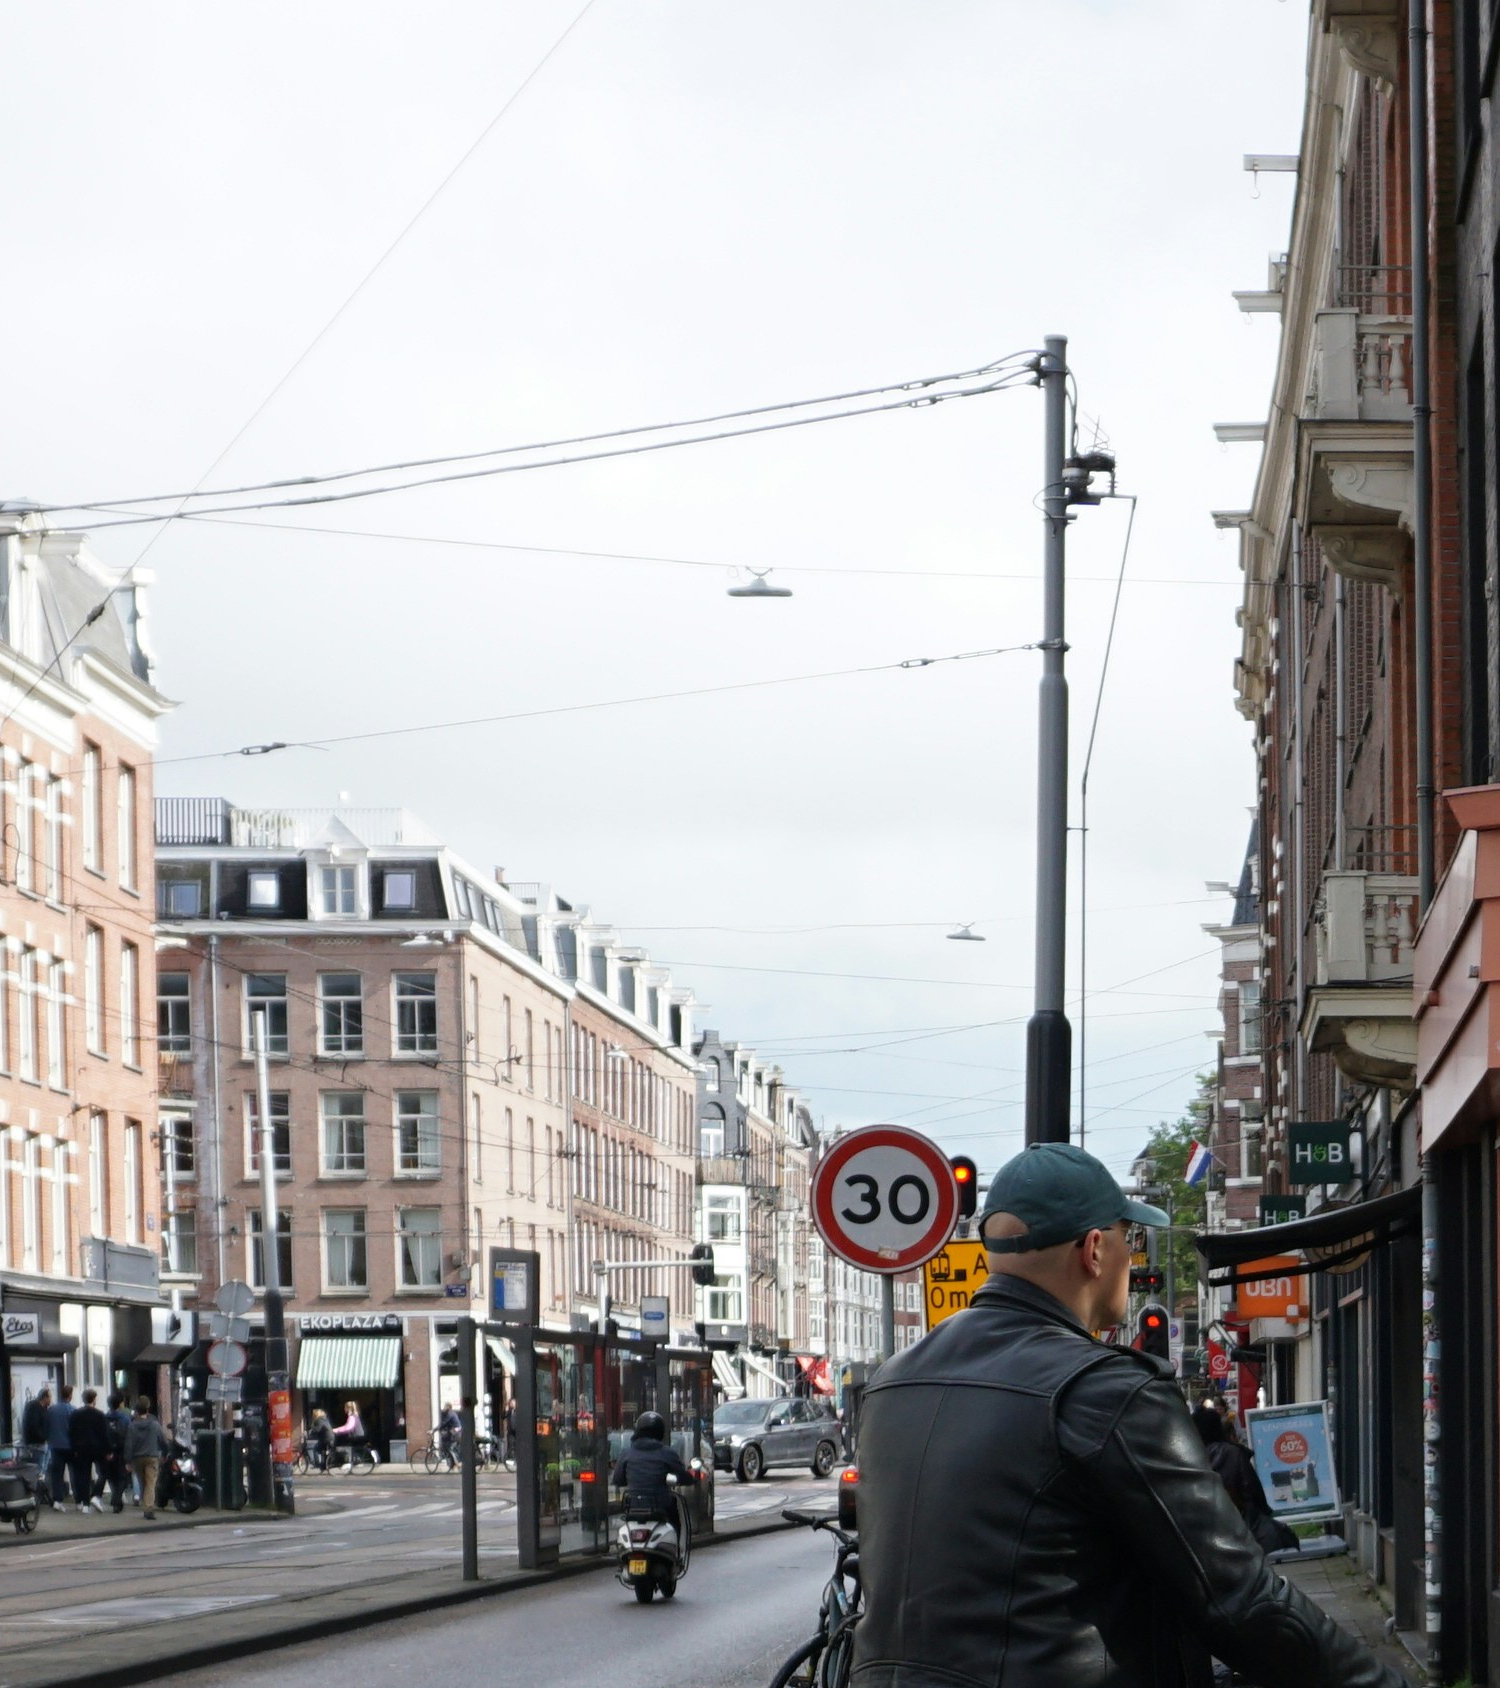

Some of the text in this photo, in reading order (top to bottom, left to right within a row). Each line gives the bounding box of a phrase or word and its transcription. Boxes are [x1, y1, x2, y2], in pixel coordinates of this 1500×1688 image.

[1294, 1142, 1344, 1164] H&B
[841, 1174, 930, 1225] 30
[973, 1252, 990, 1276] A
[930, 1286, 976, 1309] Om
[5, 1317, 34, 1339] Etos
[300, 1314, 382, 1330] EKOPLAZA
[1279, 1439, 1304, 1453] 60%
